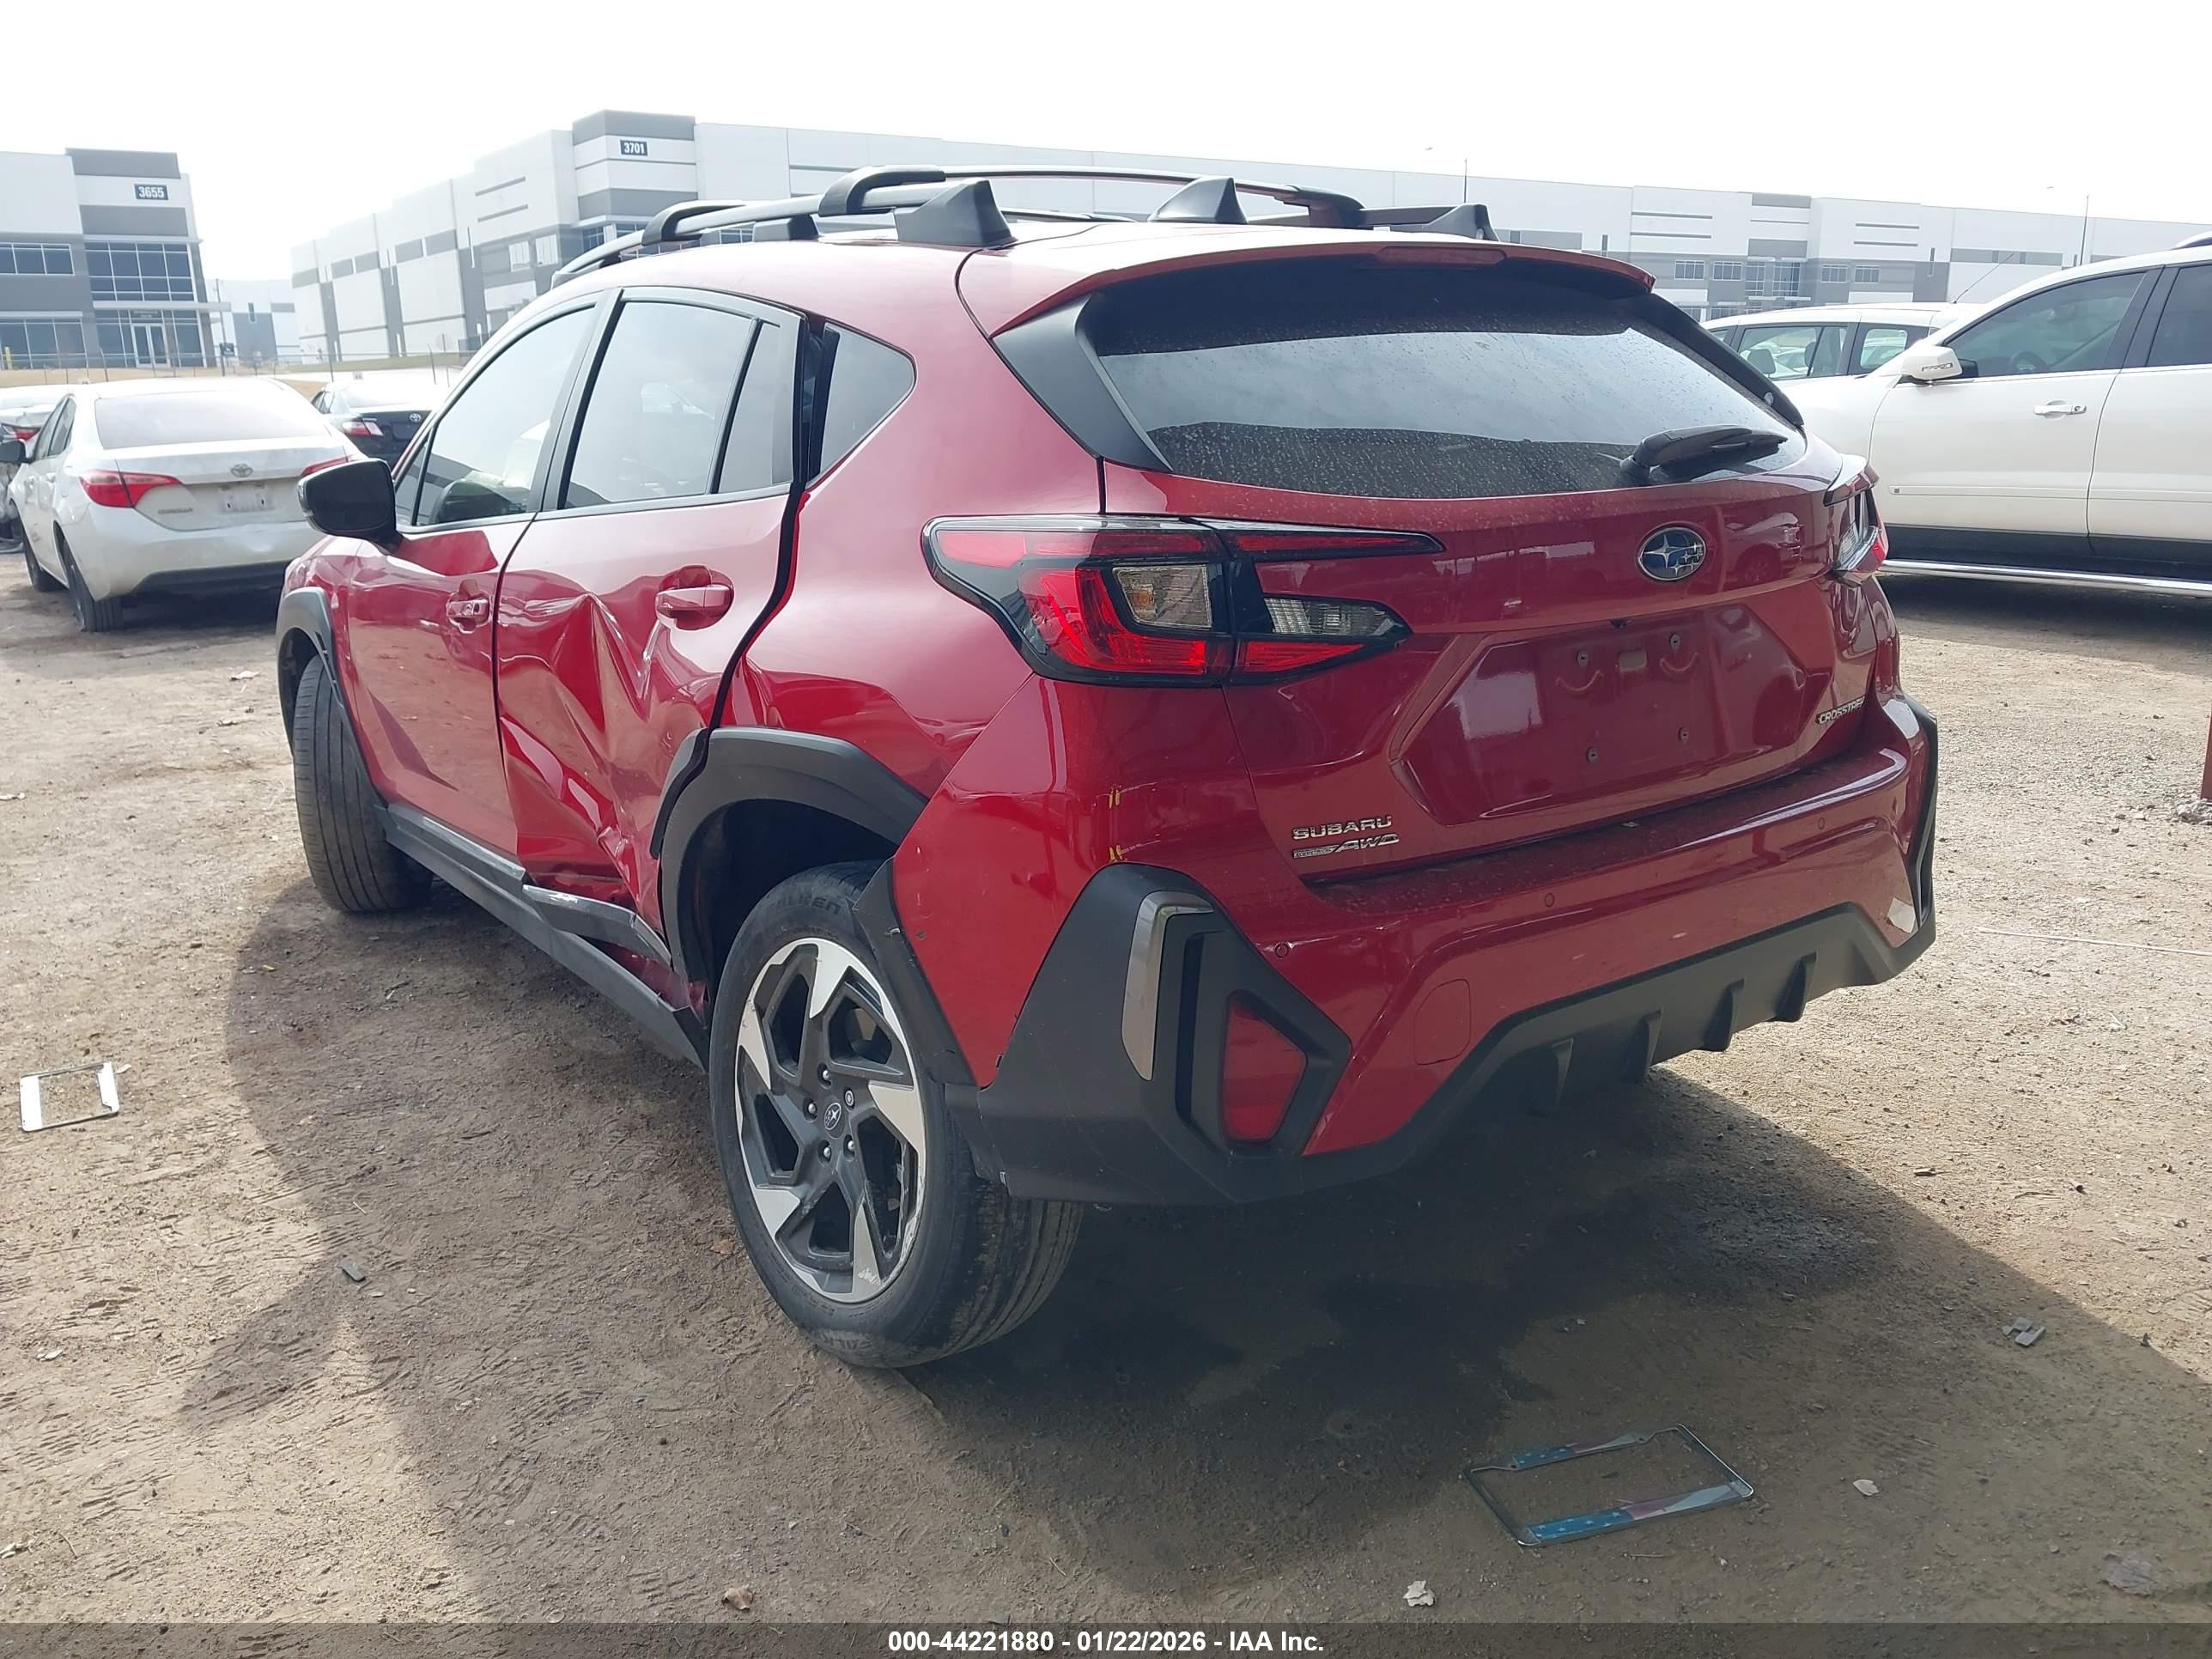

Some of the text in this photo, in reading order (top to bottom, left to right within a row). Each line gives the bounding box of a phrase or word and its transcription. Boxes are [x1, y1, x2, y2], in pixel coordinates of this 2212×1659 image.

[624, 142, 645, 155] 3701
[138, 186, 164, 198] 3655
[1293, 816, 1392, 840] SUBARU
[1335, 833, 1400, 853] AWD
[767, 893, 842, 915] ALKEN
